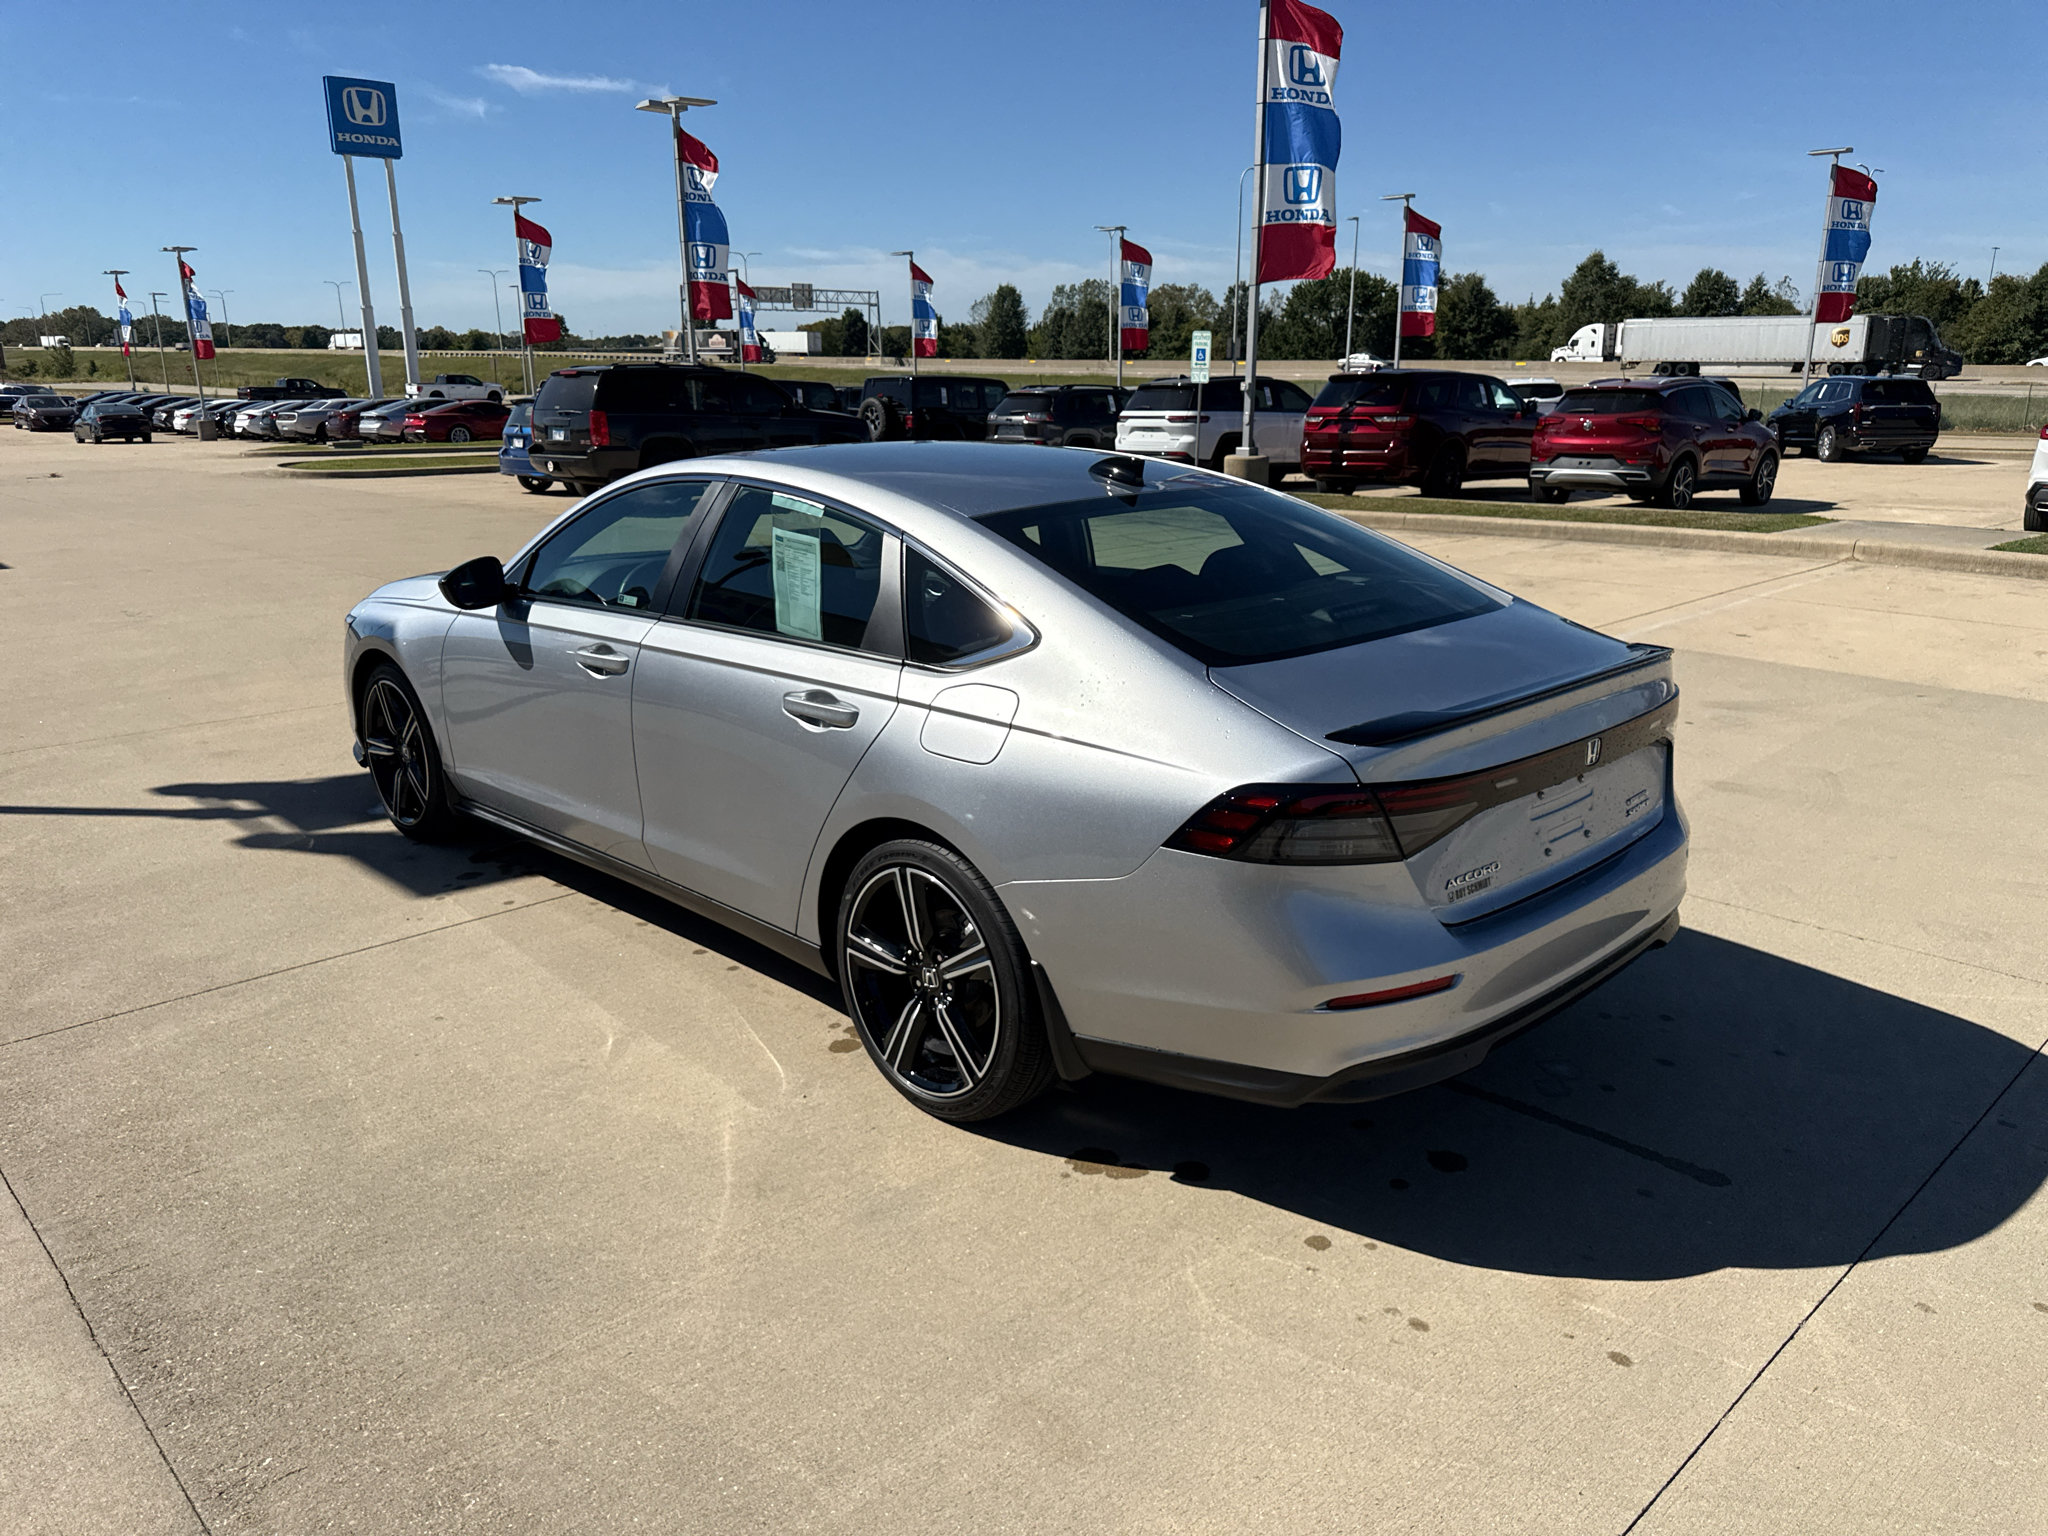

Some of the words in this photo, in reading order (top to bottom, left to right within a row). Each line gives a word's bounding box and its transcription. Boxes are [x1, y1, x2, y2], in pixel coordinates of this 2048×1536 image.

[1271, 87, 1332, 106] HOND
[336, 132, 400, 147] HONDA
[1266, 208, 1332, 223] HONDA
[1823, 284, 1855, 292] HOND
[1832, 332, 1849, 347] ups
[1445, 861, 1501, 890] ACCORD
